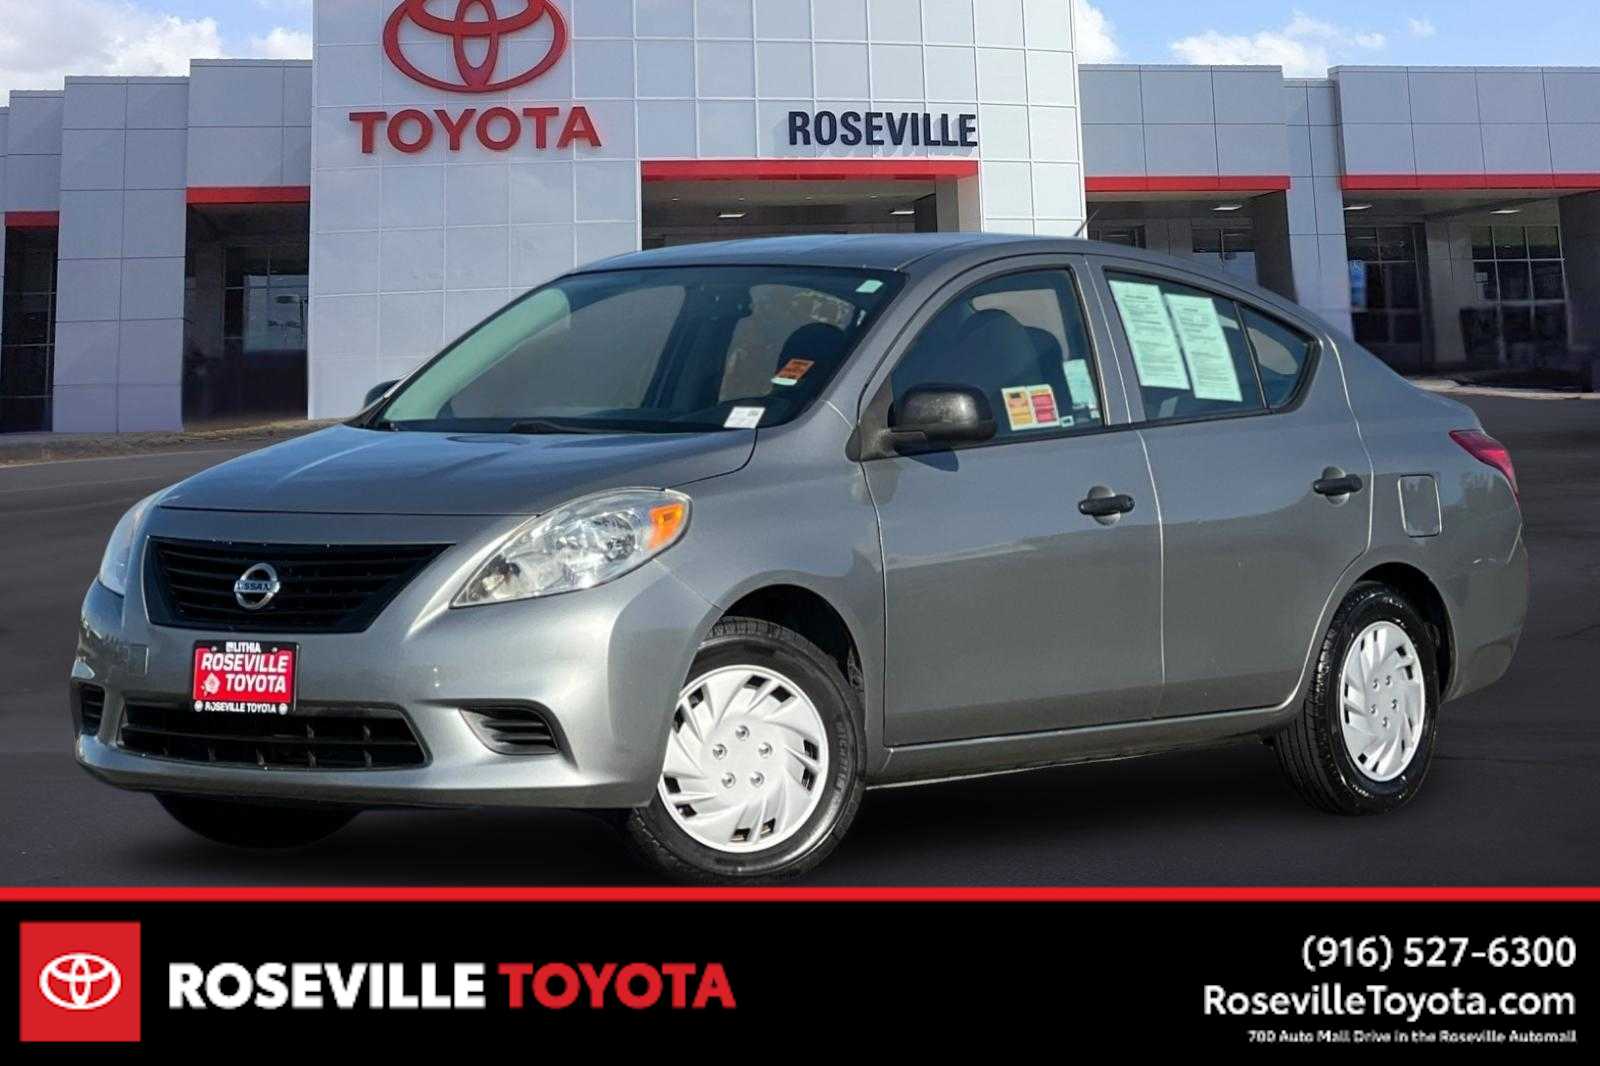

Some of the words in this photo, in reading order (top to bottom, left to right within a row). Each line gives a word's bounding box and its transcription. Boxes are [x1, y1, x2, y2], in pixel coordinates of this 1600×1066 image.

[349, 106, 602, 154] TOYOTA
[788, 110, 978, 147] ROSEVILLE
[201, 653, 288, 672] ROSEVILLE
[225, 674, 286, 693] TOYOTA
[205, 702, 245, 712] ROSEVILLE
[247, 703, 276, 713] TOYOTA
